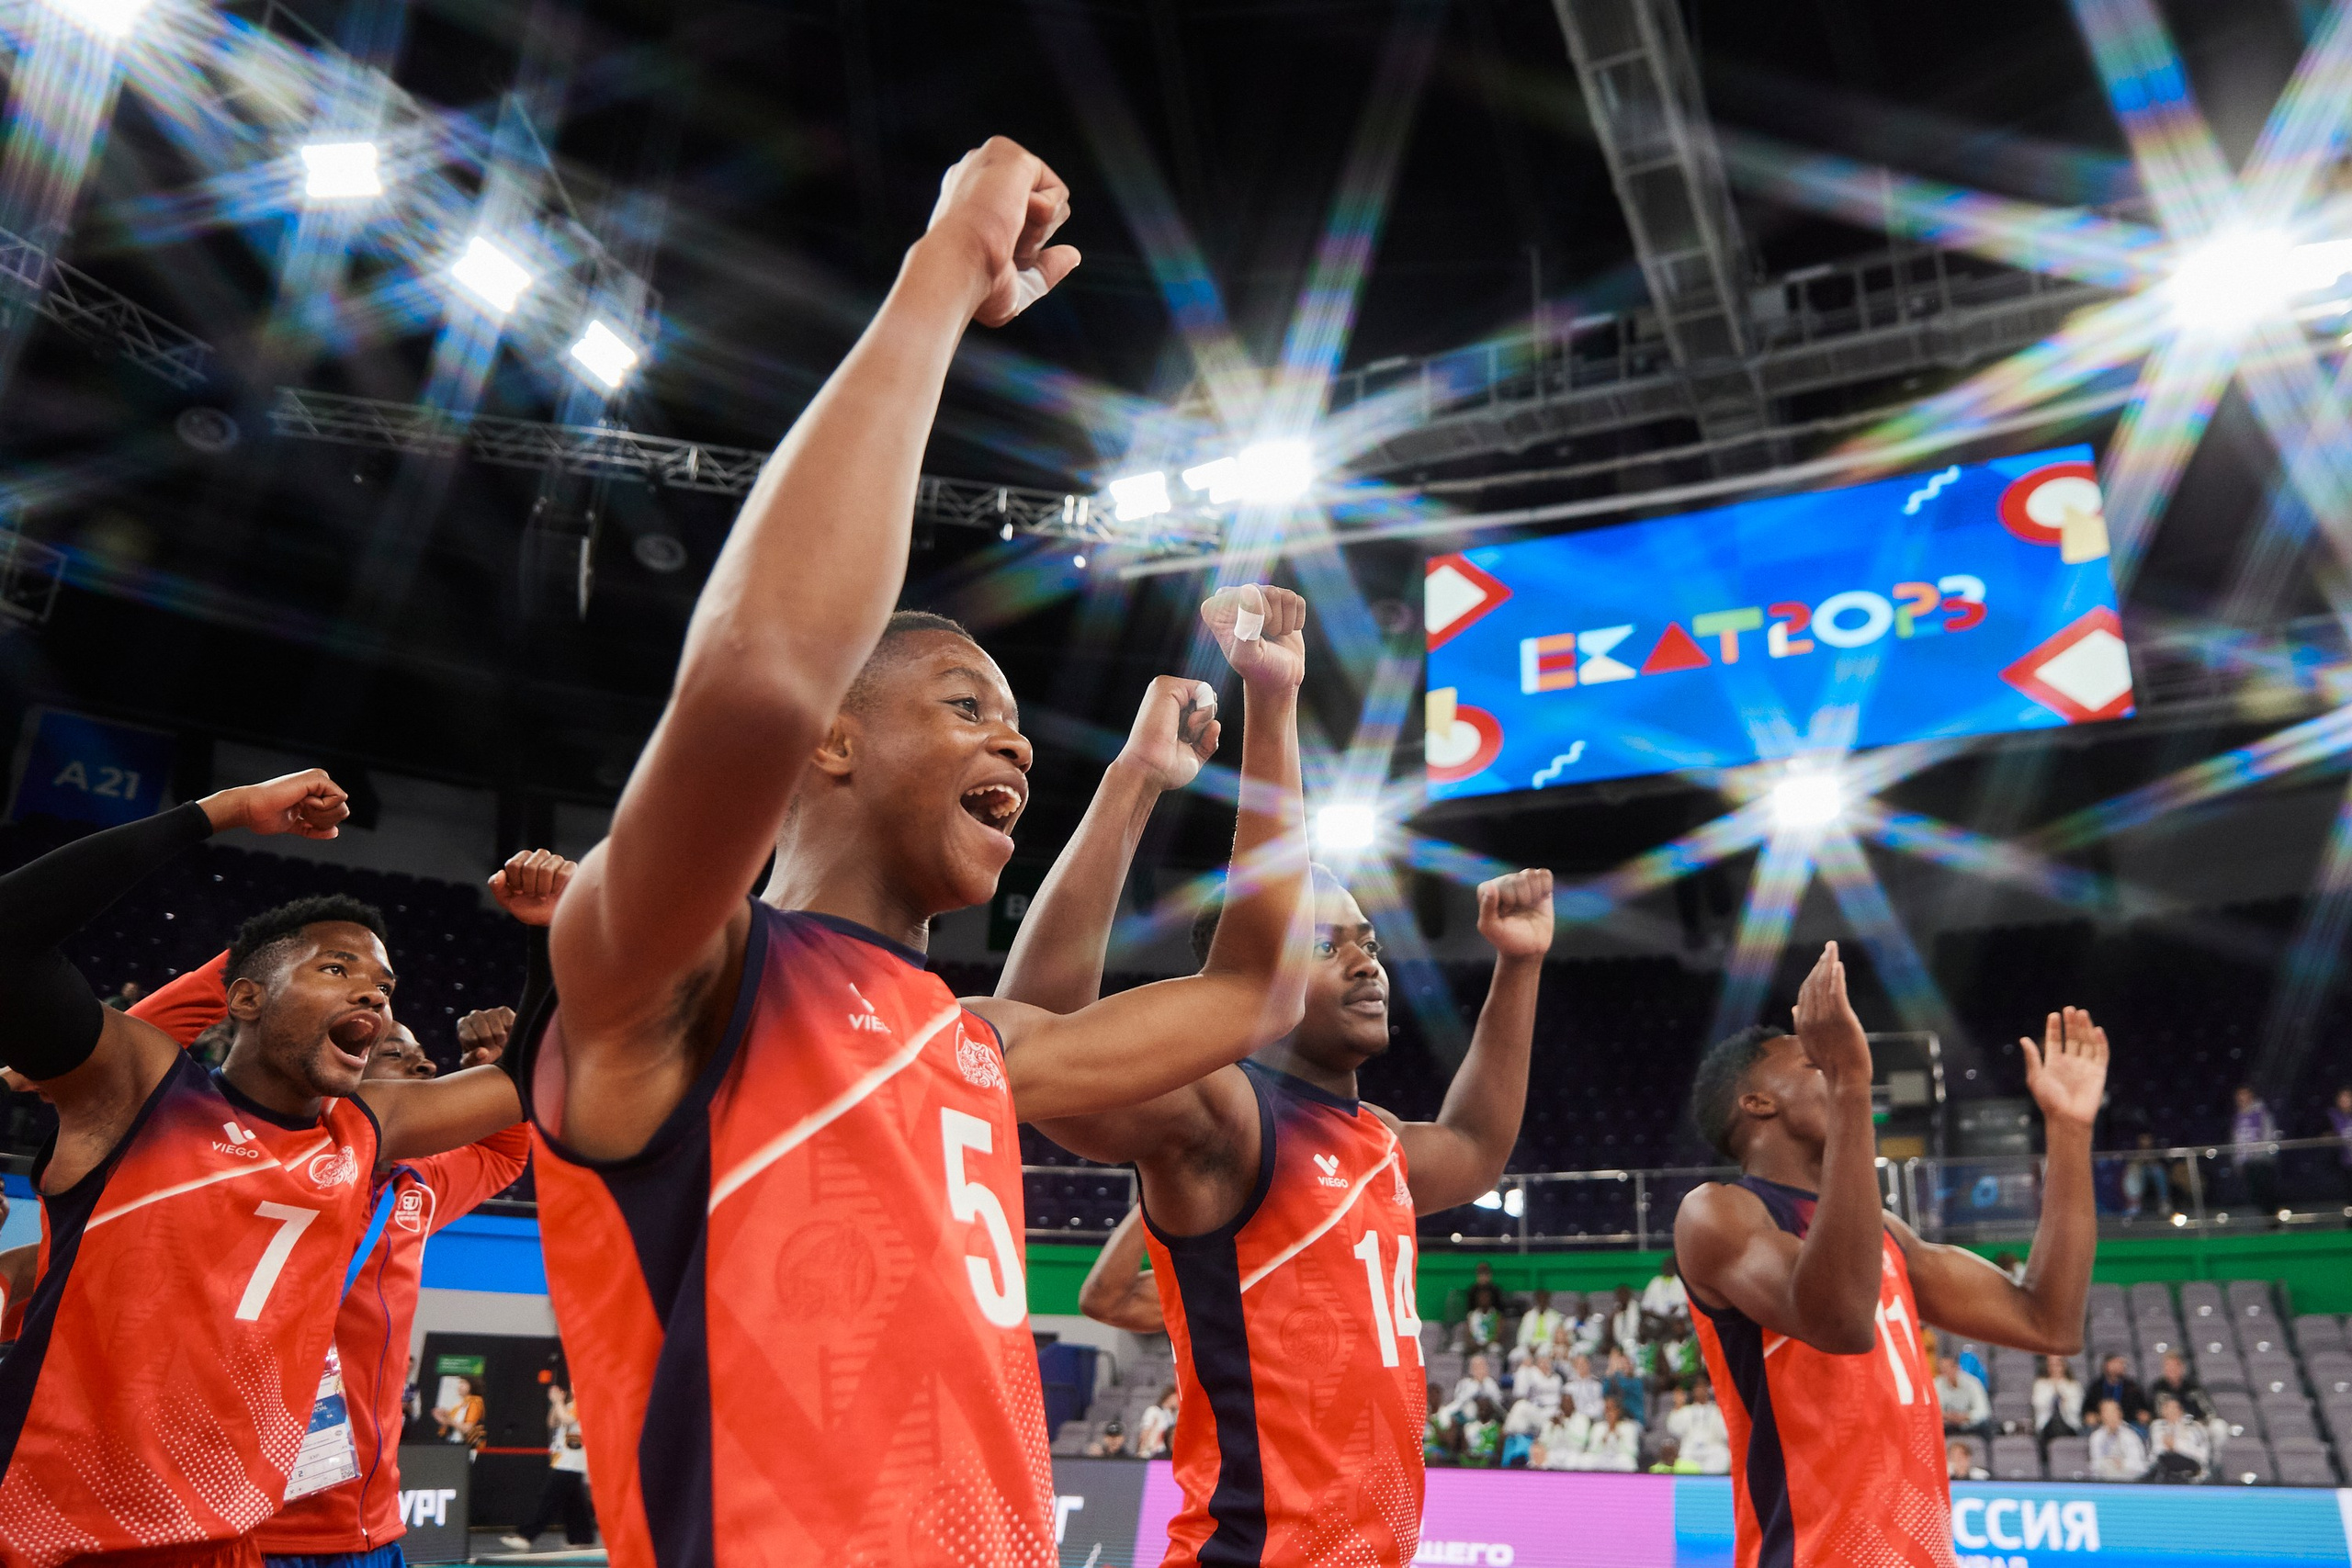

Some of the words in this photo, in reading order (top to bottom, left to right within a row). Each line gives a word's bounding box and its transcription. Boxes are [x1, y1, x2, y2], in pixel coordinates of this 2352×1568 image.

[849, 1013, 892, 1033] VIE
[212, 1141, 259, 1158] VIEGO
[1317, 1176, 1349, 1189] VIEGO
[941, 1106, 1027, 1327] 5
[234, 1200, 321, 1321] 7
[1353, 1230, 1425, 1368] 14
[1951, 1497, 2101, 1552] ССИЯ
